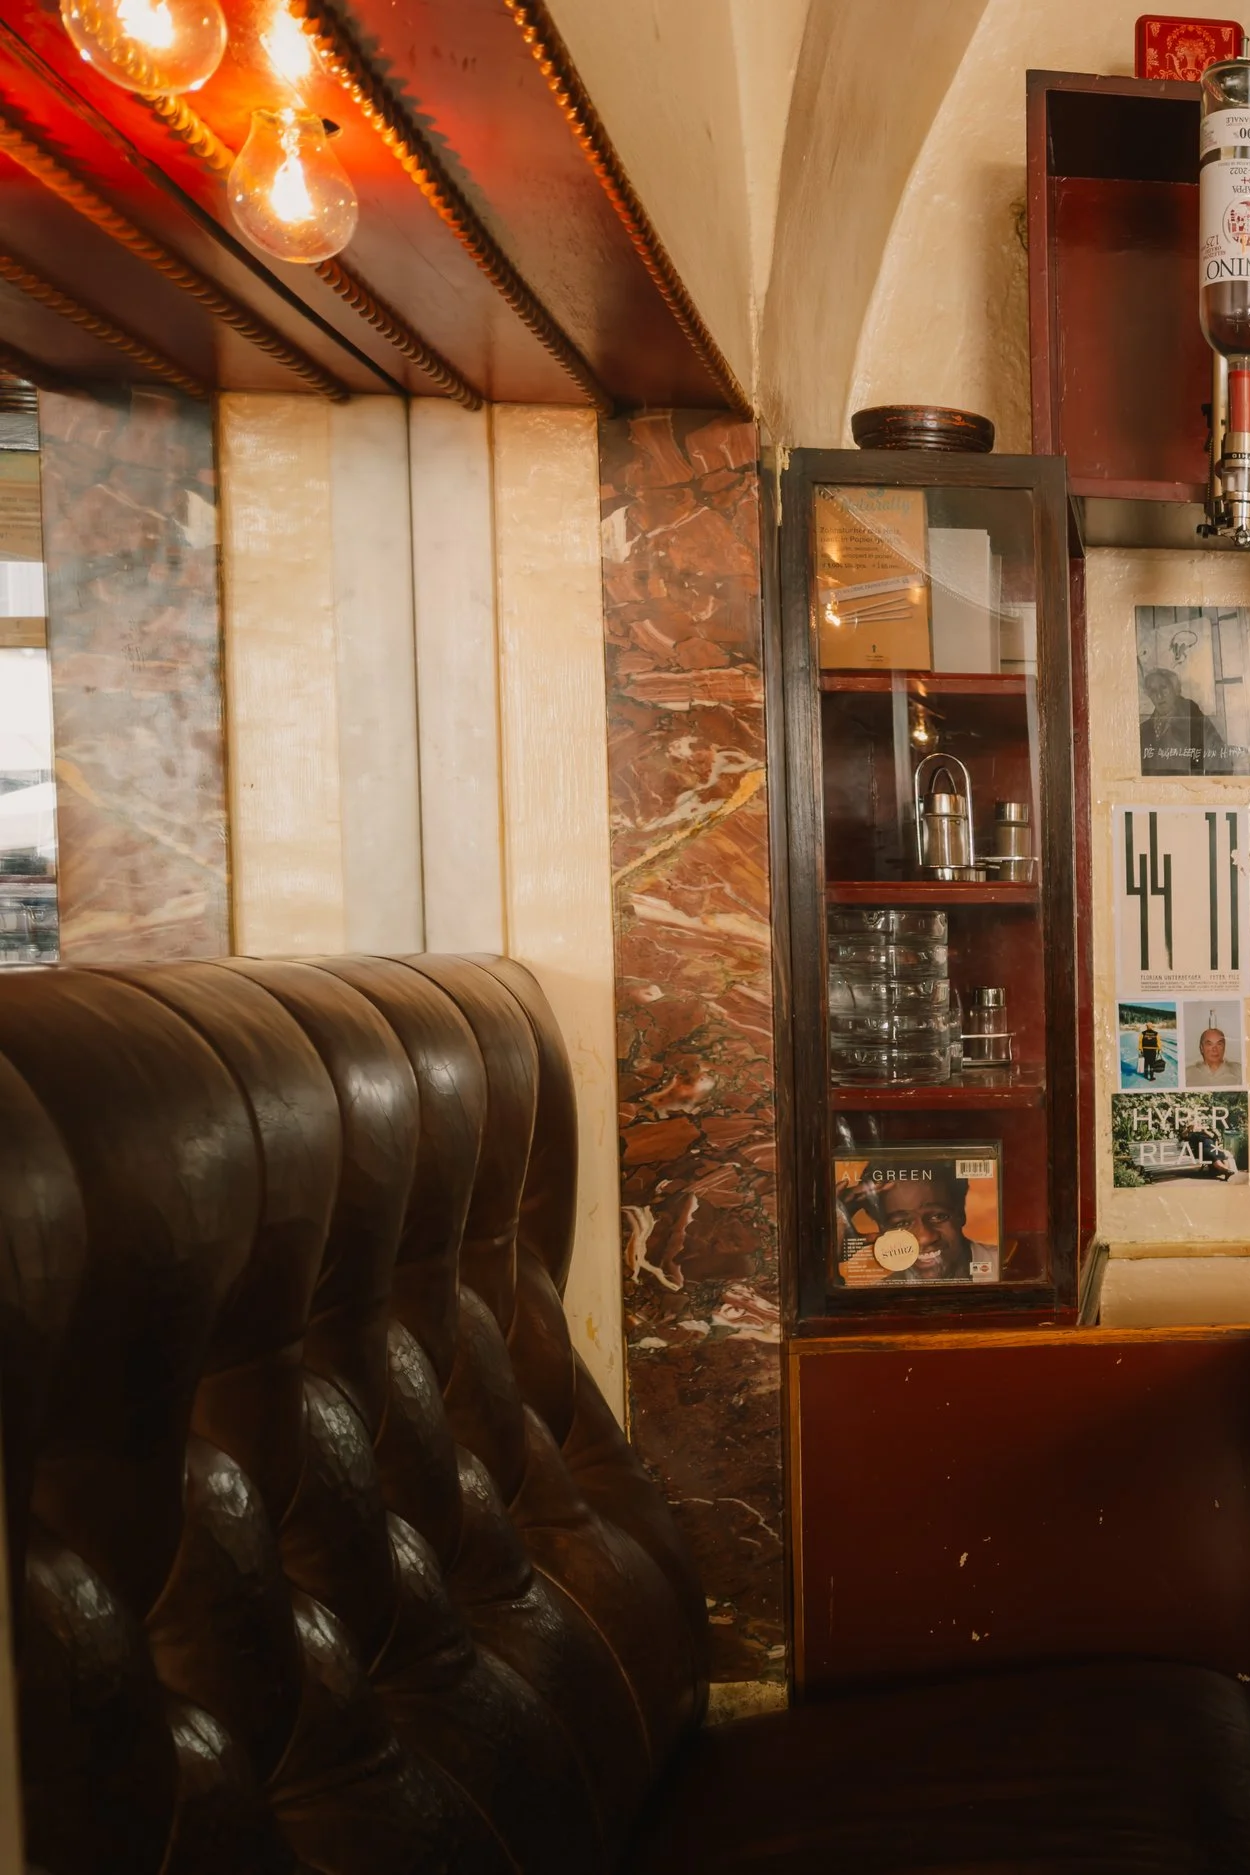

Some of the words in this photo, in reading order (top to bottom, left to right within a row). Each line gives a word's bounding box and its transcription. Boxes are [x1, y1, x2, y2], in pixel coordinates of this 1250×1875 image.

[1132, 1105, 1230, 1131] HYPER
[840, 1170, 862, 1182] AL
[872, 1169, 933, 1182] GREEN
